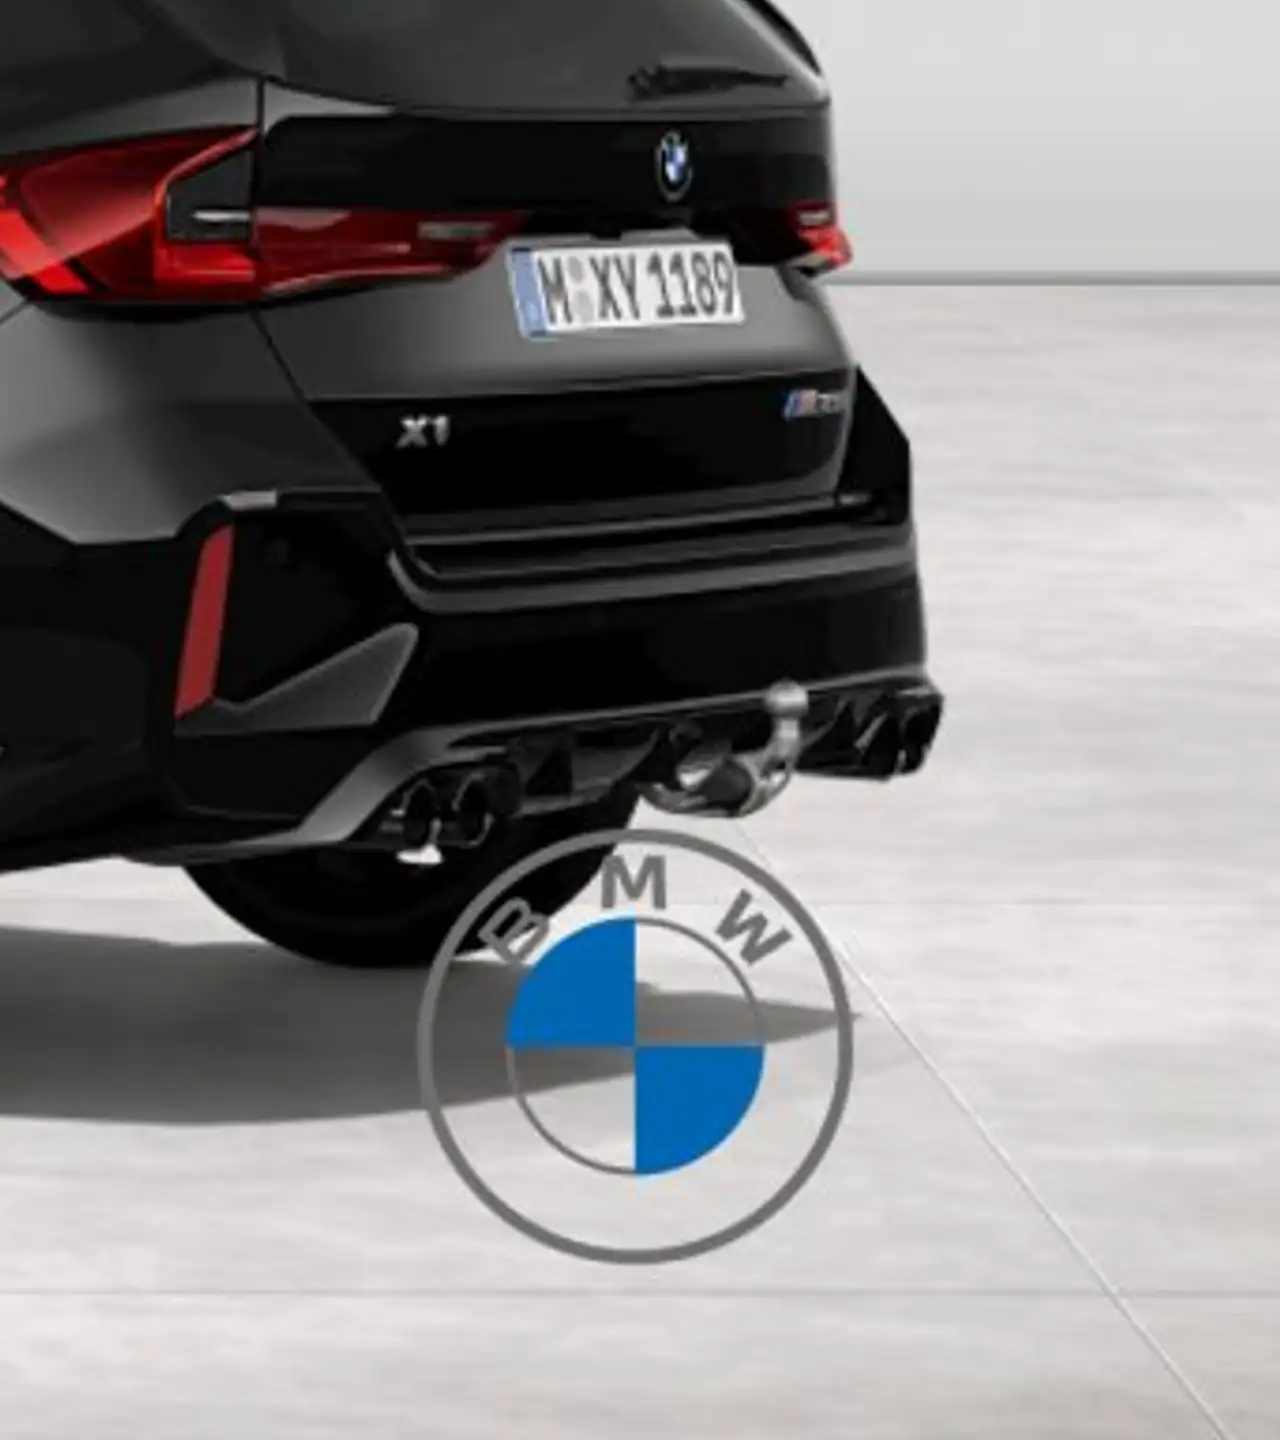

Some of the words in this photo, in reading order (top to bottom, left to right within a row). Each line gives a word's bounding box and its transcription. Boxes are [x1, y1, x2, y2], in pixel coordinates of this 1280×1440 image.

[590, 253, 641, 320] XY
[646, 251, 736, 317] 1189
[395, 414, 450, 449] X1
